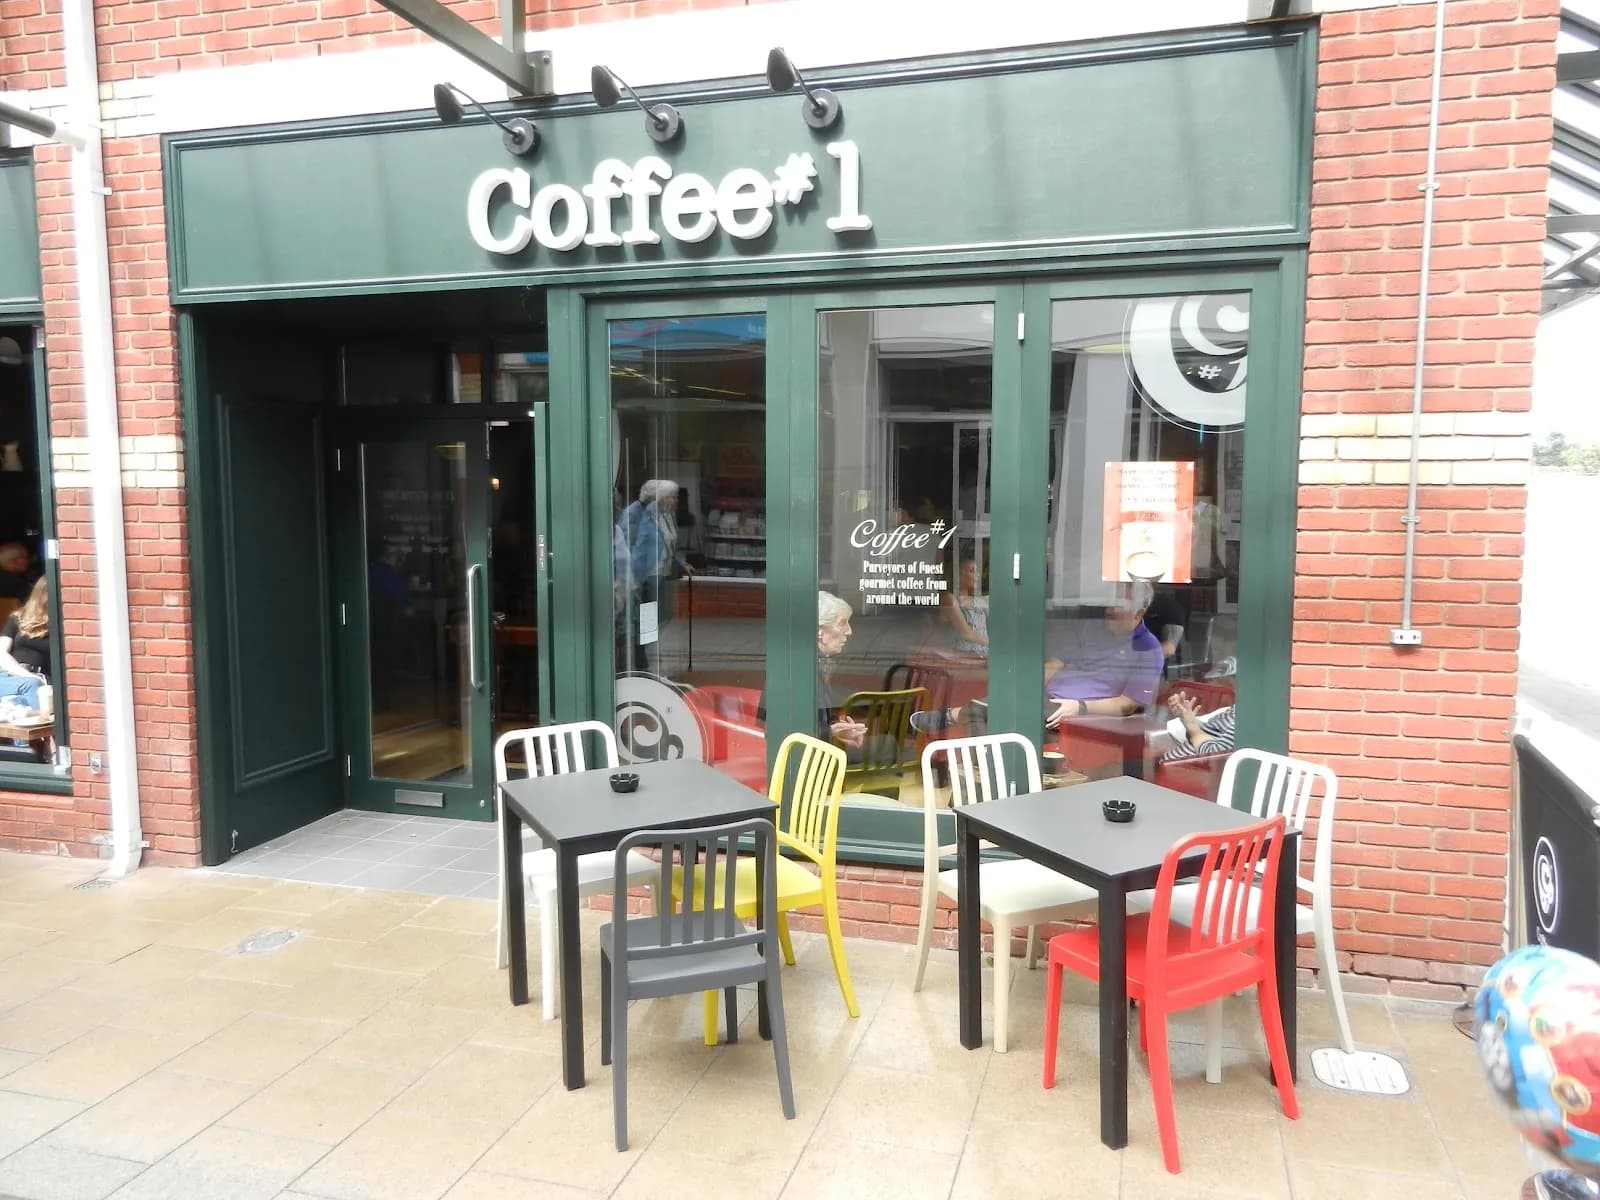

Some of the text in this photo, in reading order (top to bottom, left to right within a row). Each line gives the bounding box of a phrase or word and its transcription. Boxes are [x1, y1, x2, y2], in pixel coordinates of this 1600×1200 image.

[863, 560, 944, 576] Purveyors of finest
[859, 577, 948, 591] gourmet coffee from
[866, 592, 940, 606] around the world
